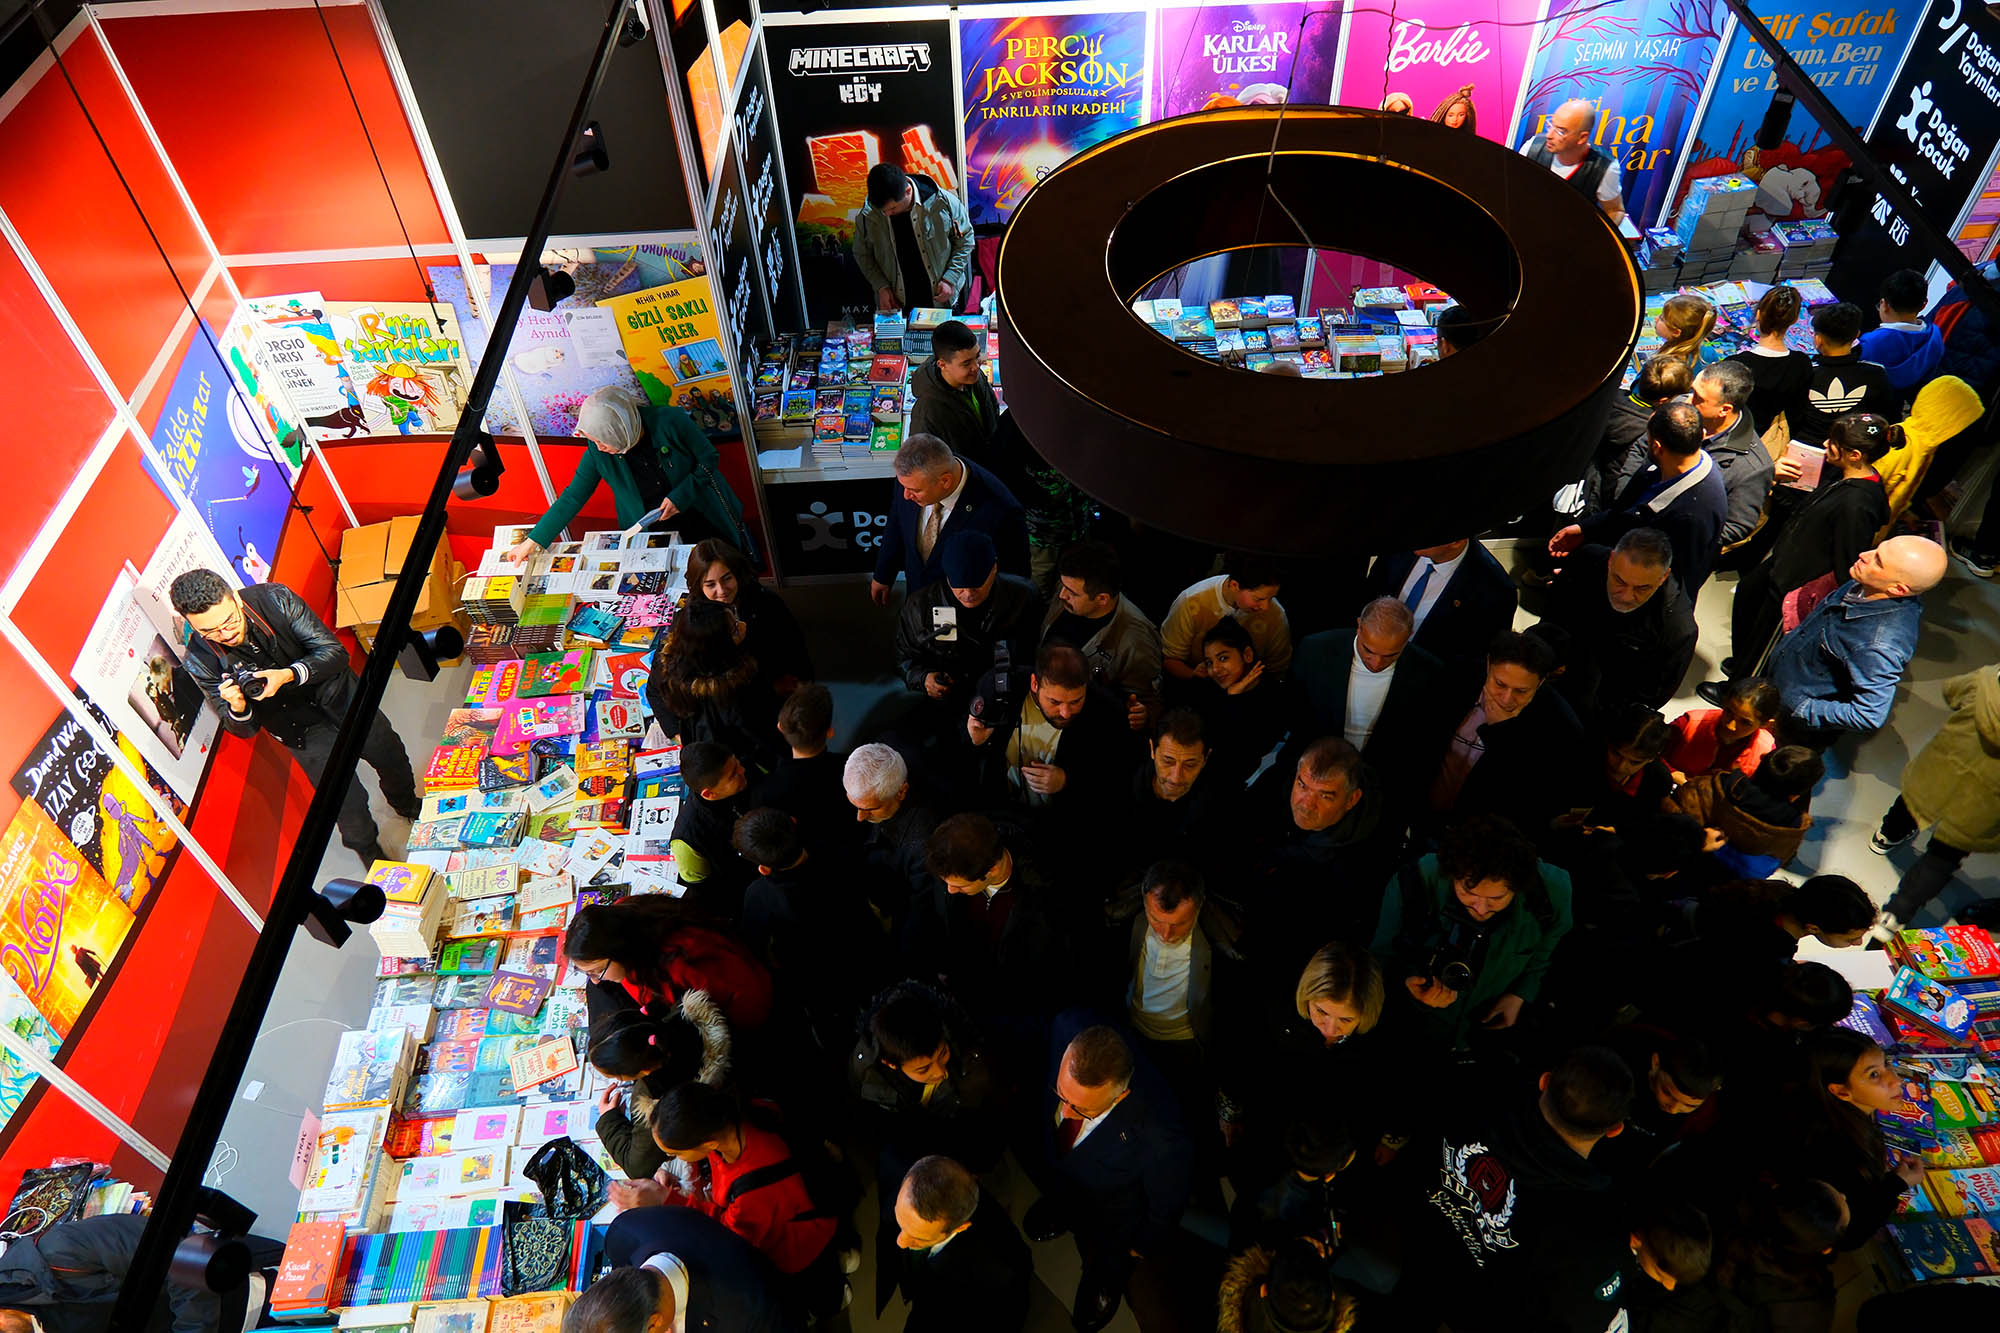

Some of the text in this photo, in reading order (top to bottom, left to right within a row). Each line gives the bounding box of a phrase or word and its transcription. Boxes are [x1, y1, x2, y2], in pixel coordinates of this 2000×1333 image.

[1807, 8, 1899, 44] Şafak
[789, 43, 931, 76] MINECRAFT
[1005, 34, 1105, 62] PERCY
[1203, 32, 1291, 57] KARLAR
[1384, 18, 1490, 73] Barbie
[1574, 38, 1681, 65] ŞERMİN YAŞAR
[1744, 43, 1882, 69] Usam, Ben
[1213, 52, 1277, 74] ÜLKESİ
[980, 60, 1129, 103] JACKSON
[1733, 76, 1759, 93] ve
[1844, 64, 1878, 85] Fil
[981, 100, 1125, 119] TANRILARIN KADEHİ
[1010, 91, 1023, 100] VE
[1928, 107, 1970, 162] Doğan
[1917, 132, 1956, 181] Çocuk
[627, 298, 709, 330] GİZLİ SAKLI
[842, 305, 869, 314] MAX
[656, 322, 699, 345] İŞLER
[499, 668, 517, 698] ELMER
[521, 658, 538, 690] ELMER
[25, 737, 66, 800] David
[44, 771, 79, 824] UZAY
[551, 1003, 561, 1029] UÇAN
[1445, 1174, 1492, 1244] ADIDAS
